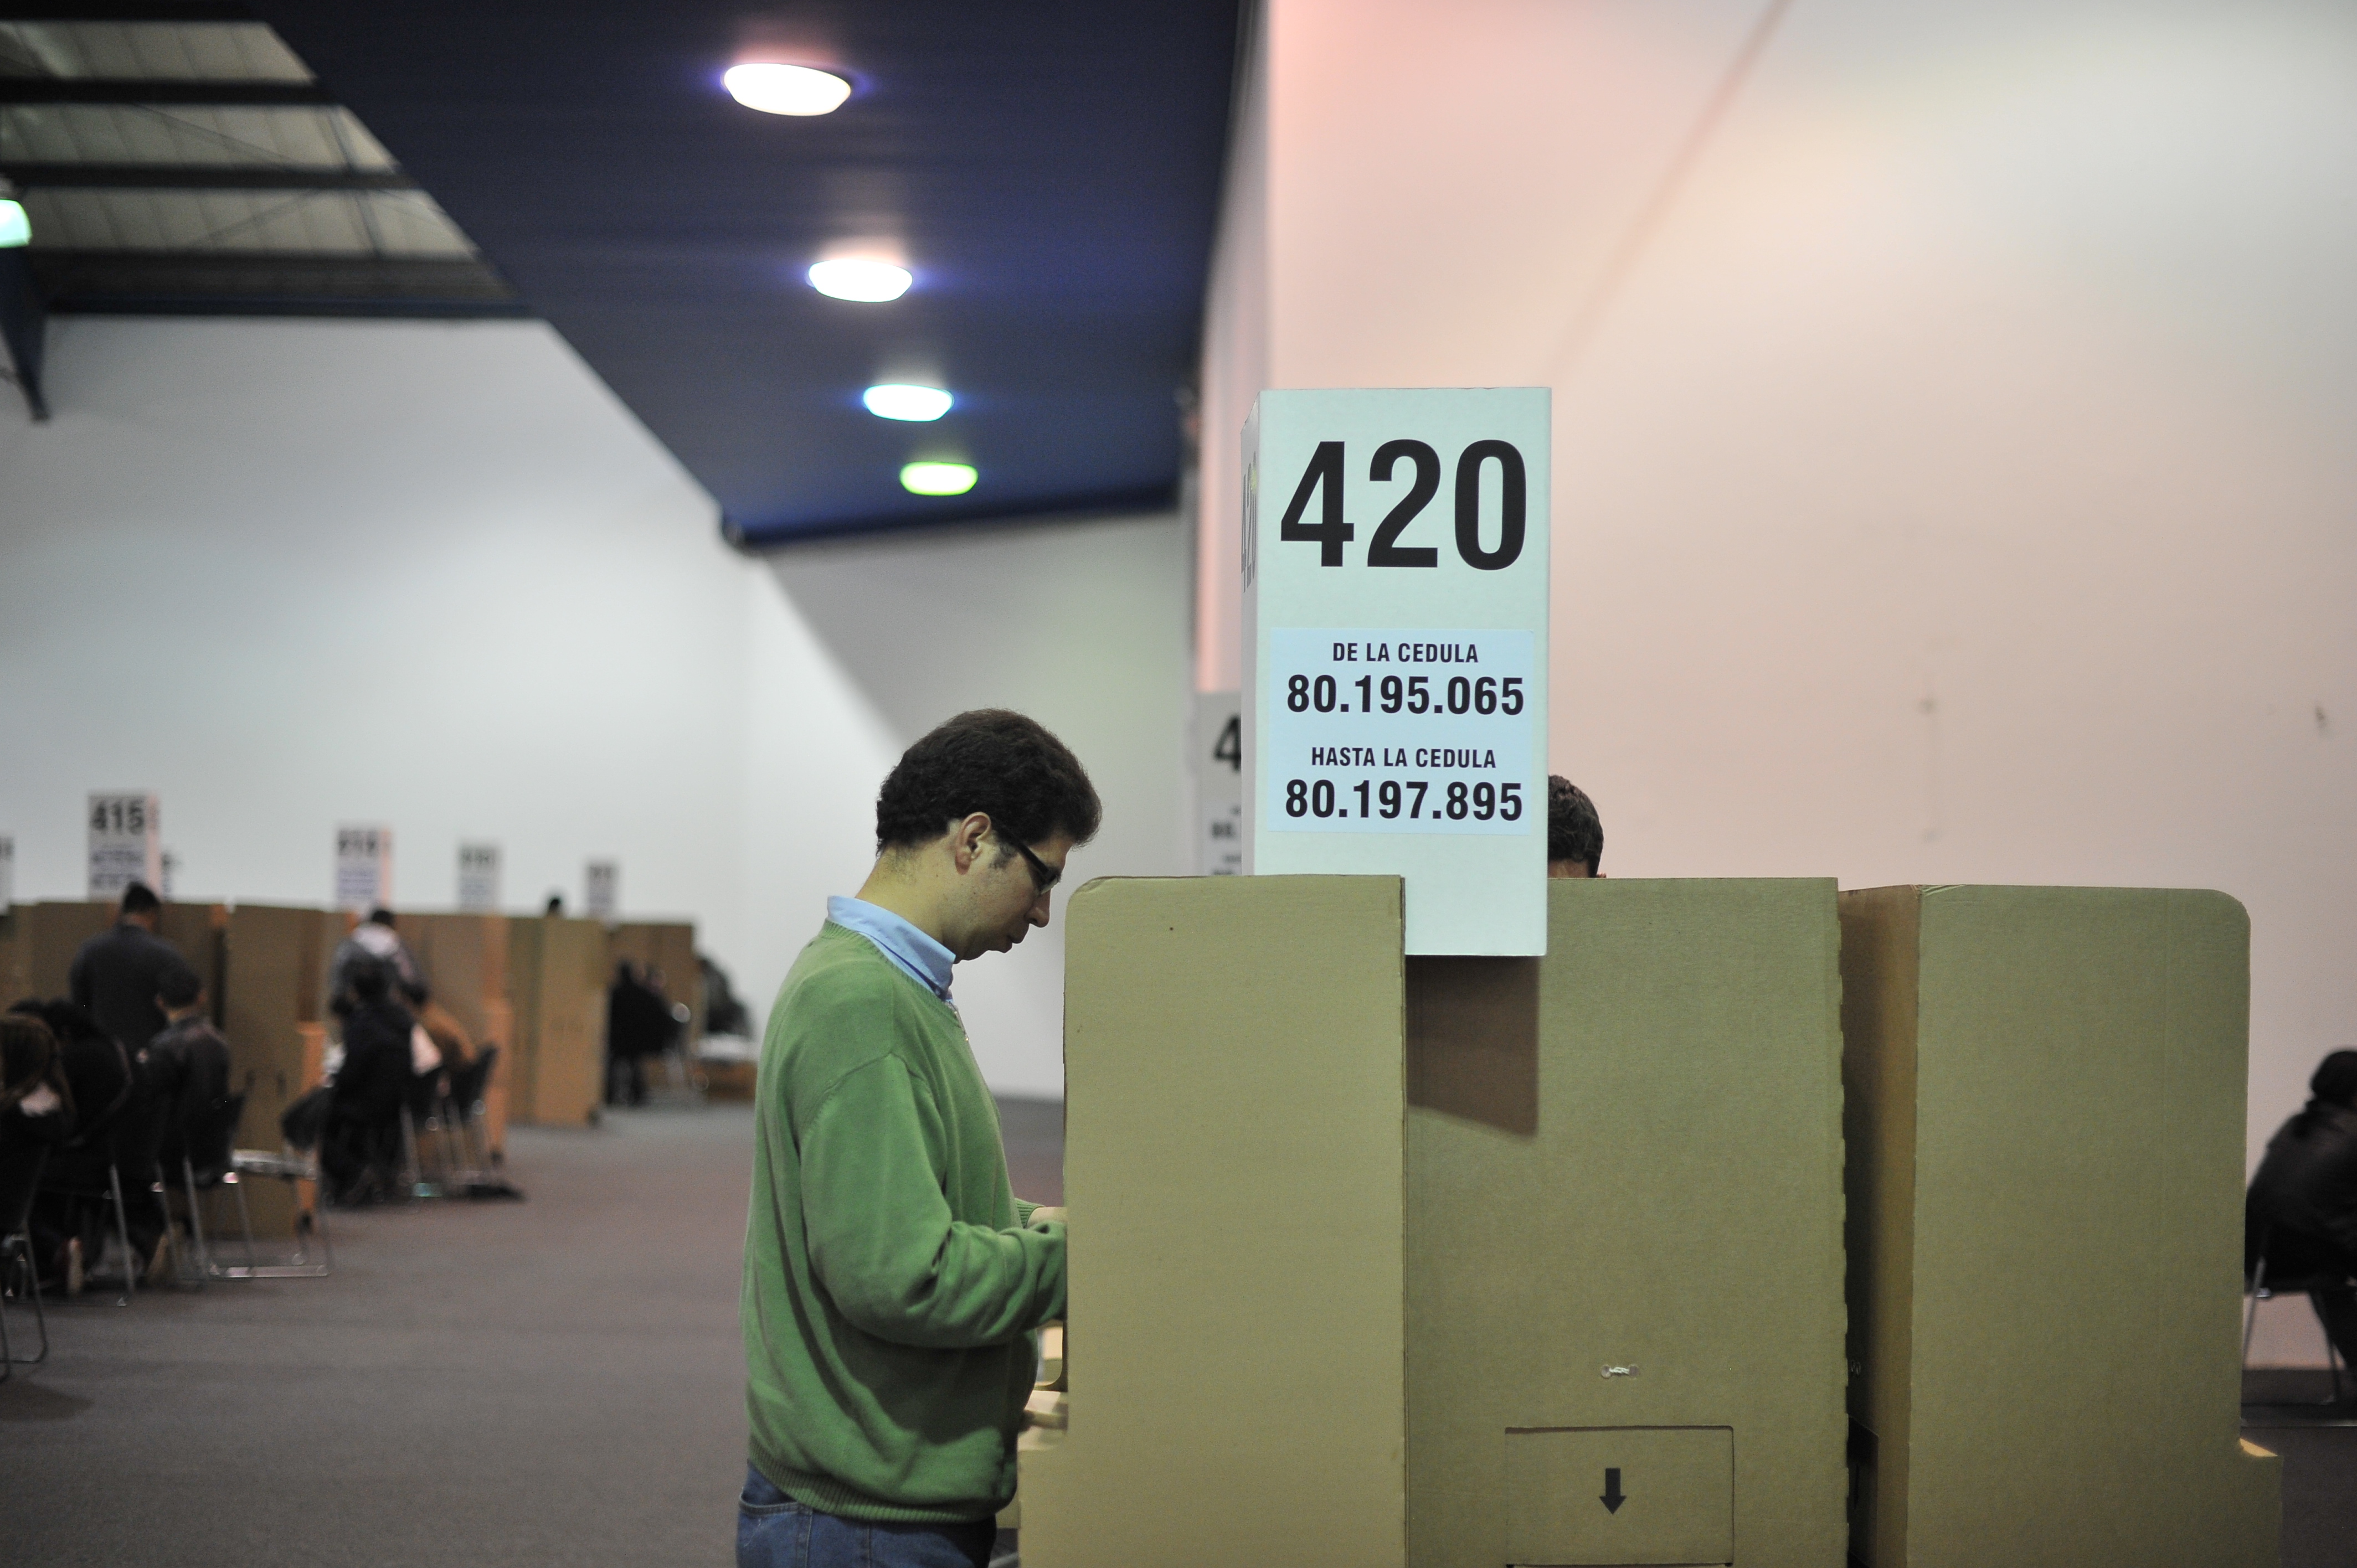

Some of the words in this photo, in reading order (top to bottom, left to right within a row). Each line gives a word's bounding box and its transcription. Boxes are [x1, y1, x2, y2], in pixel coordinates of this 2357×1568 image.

[1280, 439, 1526, 571] 420
[1333, 642, 1358, 662] DE
[1366, 643, 1391, 662] LA
[1398, 643, 1479, 663] CEDULA
[1286, 674, 1524, 716] 80.195.065
[1311, 747, 1376, 767] HASTA
[1383, 747, 1408, 767] LA
[1415, 747, 1496, 768] CEDULA
[90, 800, 145, 834] 415
[1285, 779, 1522, 822] 80.197.895
